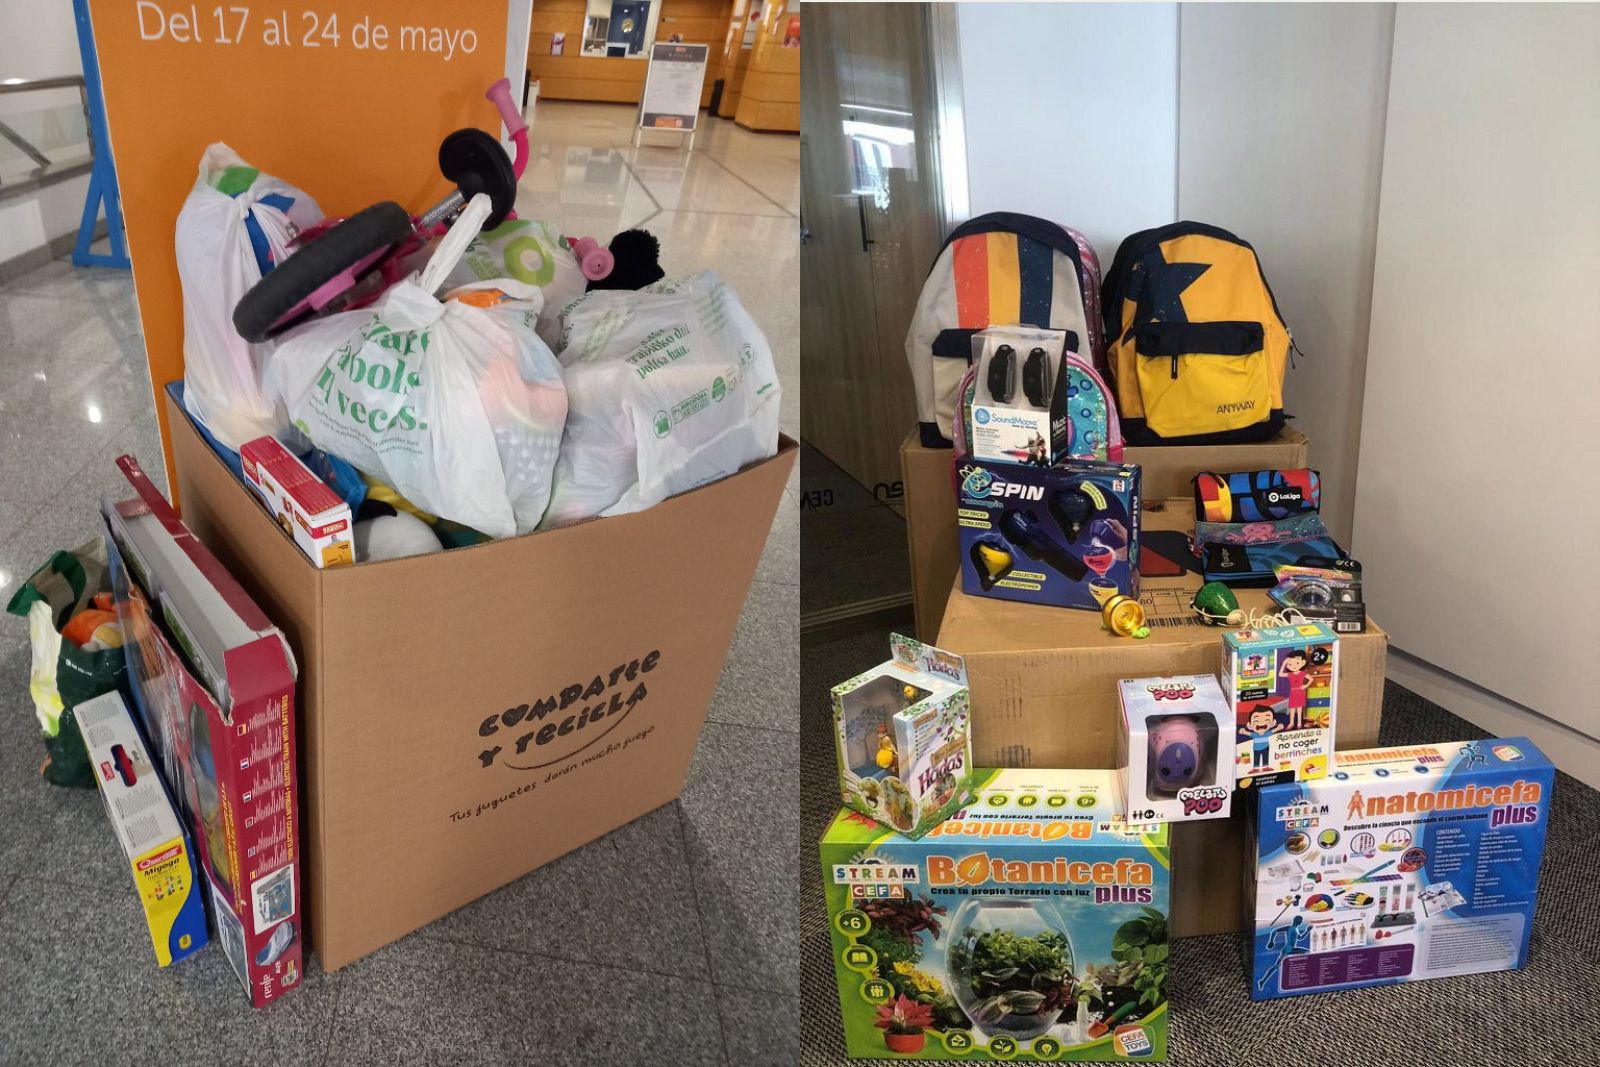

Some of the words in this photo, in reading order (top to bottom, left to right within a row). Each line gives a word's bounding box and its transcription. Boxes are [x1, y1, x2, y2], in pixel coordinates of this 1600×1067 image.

[136, 0, 201, 43] Del
[213, 6, 249, 45] 17
[263, 10, 290, 47] al
[302, 11, 341, 48] 24
[352, 15, 389, 50] de
[400, 25, 477, 61] mayo
[1216, 400, 1256, 415] ANYWAY
[1313, 652, 1325, 662] 2+
[1276, 729, 1314, 742] Aprendo
[1278, 742, 1290, 750] no
[1293, 738, 1320, 750] coger
[1274, 747, 1323, 760] berrinches
[450, 808, 472, 822] Tus
[475, 782, 537, 817] juguetes
[544, 764, 577, 784] darán
[582, 741, 621, 767] mucho
[622, 725, 656, 750] juego
[1278, 805, 1329, 818] STREAM
[1491, 805, 1538, 828] plus
[1287, 818, 1319, 829] CEFA
[1343, 823, 1371, 831] Descubre
[928, 820, 1094, 841] Botanicef
[836, 867, 916, 879] STREAM
[927, 852, 1153, 887] Botanicefa
[853, 886, 902, 896] CEFA
[930, 887, 956, 895] Crea
[958, 887, 969, 895] tu
[971, 887, 1006, 897] propio
[1008, 887, 1050, 896] Terrario
[1075, 888, 1090, 896] luz
[1095, 885, 1153, 904] plus
[843, 917, 861, 929] +6
[260, 973, 274, 998] renfe
[1120, 1031, 1145, 1043] CEFA
[1124, 1040, 1149, 1051] TOYS
